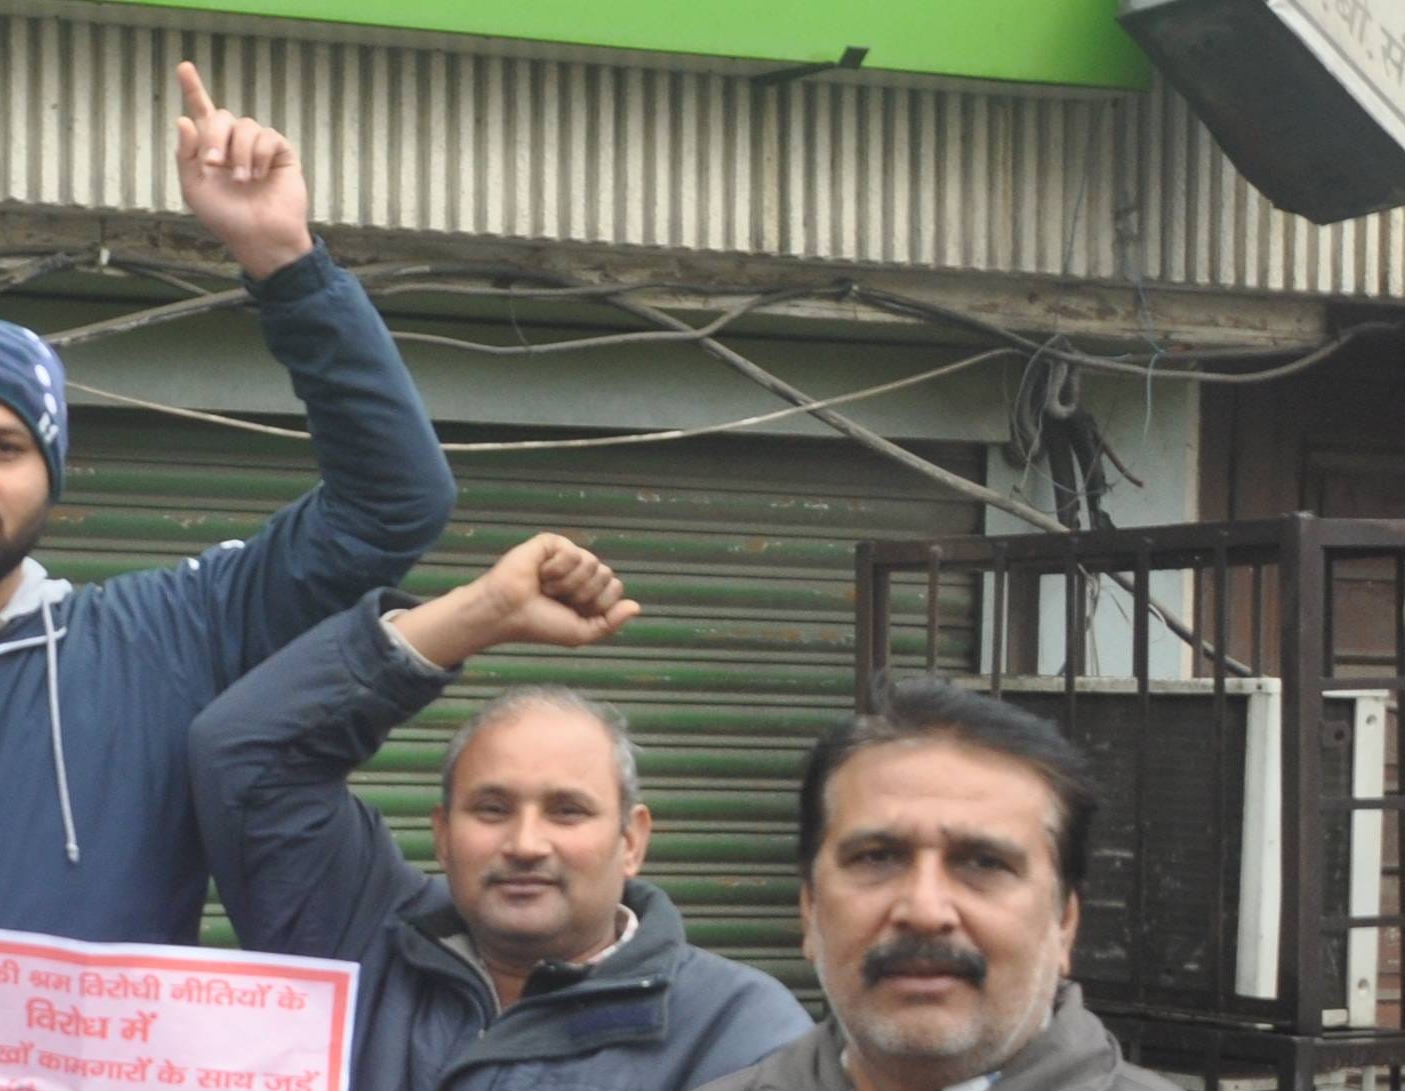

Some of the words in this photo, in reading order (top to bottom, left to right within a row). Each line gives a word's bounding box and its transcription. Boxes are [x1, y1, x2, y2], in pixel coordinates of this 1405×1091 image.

[29, 969, 72, 993] श्रम
[79, 971, 160, 1003] विरोधी
[170, 977, 271, 1008] नीतियों
[277, 986, 307, 1010] के
[25, 997, 111, 1039] विरोध
[120, 1010, 157, 1042] में
[37, 1049, 153, 1082] कामगारों
[157, 1059, 189, 1084] के
[196, 1068, 256, 1091] साथ
